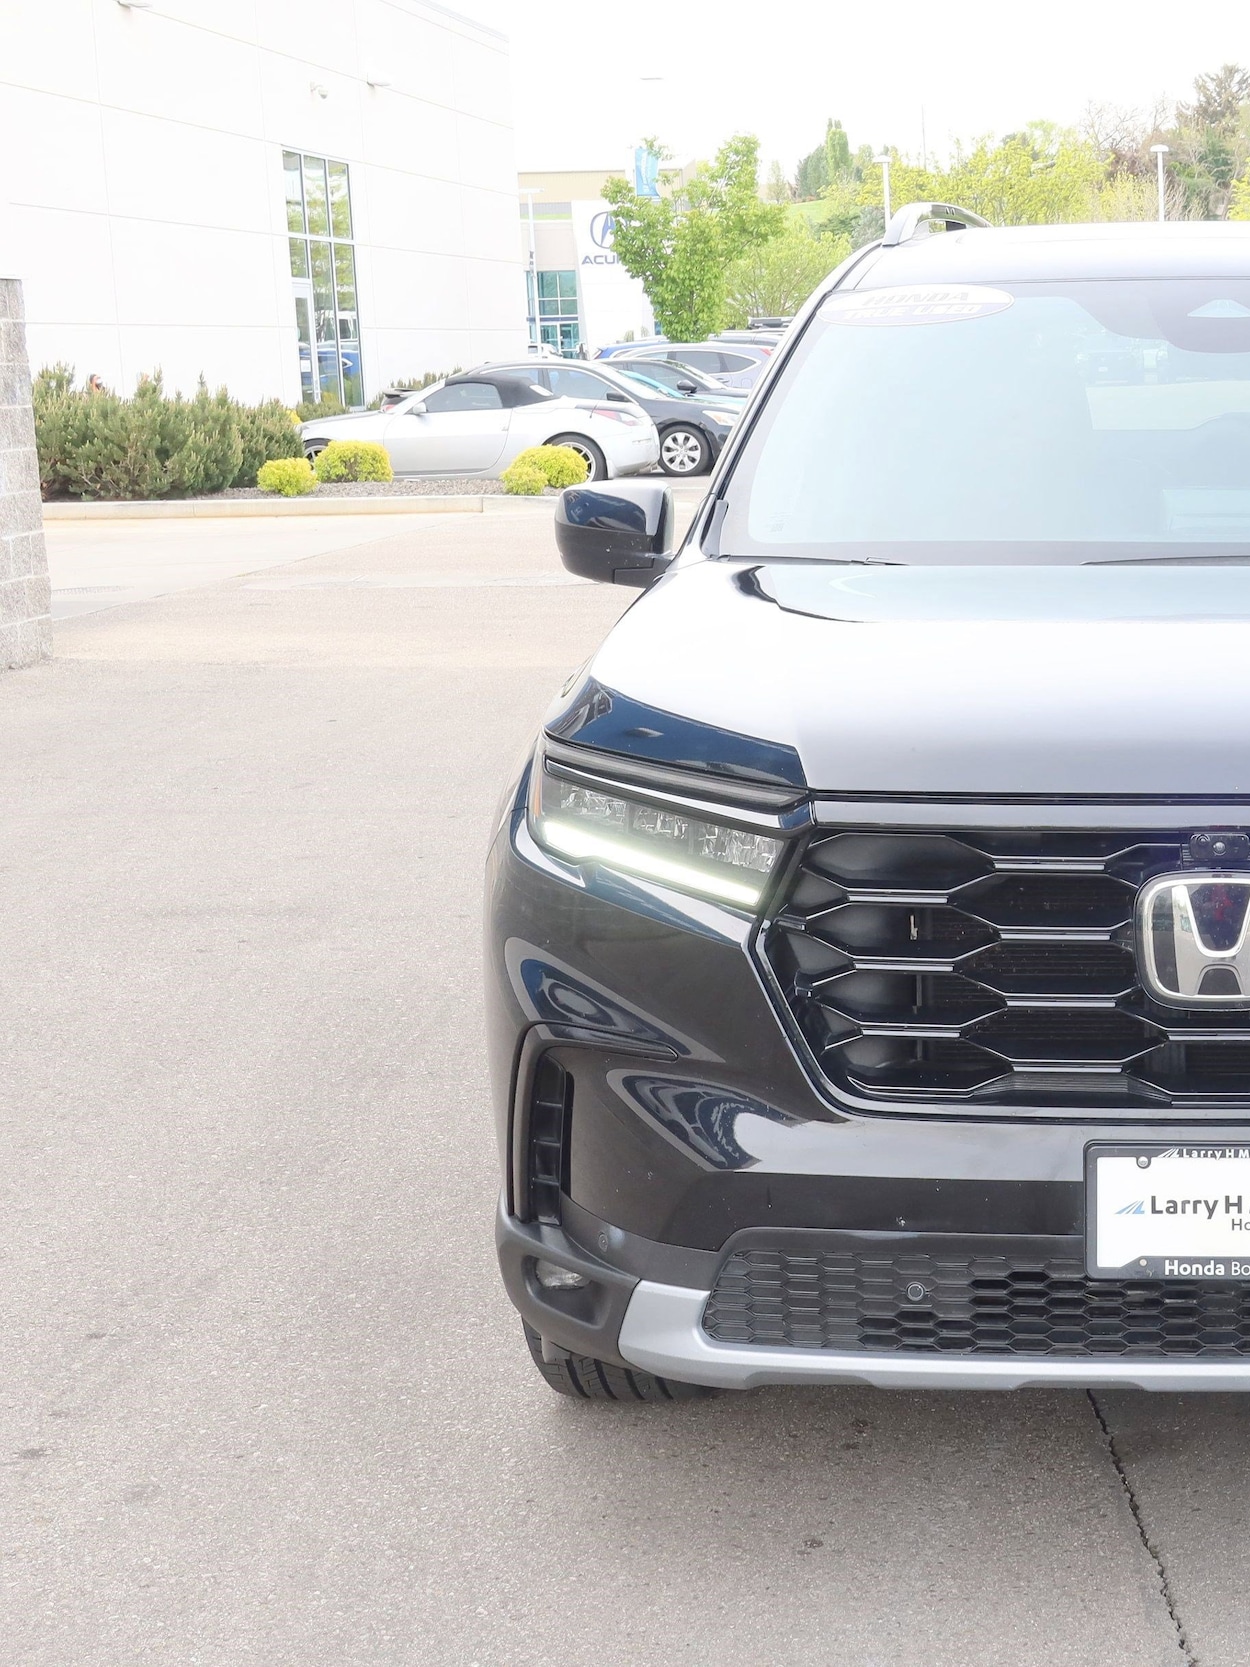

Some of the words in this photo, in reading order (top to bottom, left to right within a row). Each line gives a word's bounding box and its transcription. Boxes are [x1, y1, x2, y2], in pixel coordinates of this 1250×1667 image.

[581, 255, 620, 265] ACU
[861, 292, 969, 306] HONDA
[844, 306, 909, 320] TRUE
[912, 304, 983, 316] USED
[1182, 1149, 1222, 1160] Larry
[1226, 1149, 1233, 1158] H
[1151, 1195, 1219, 1220] Larry
[1224, 1195, 1243, 1214] H
[1164, 1259, 1225, 1276] Honda
